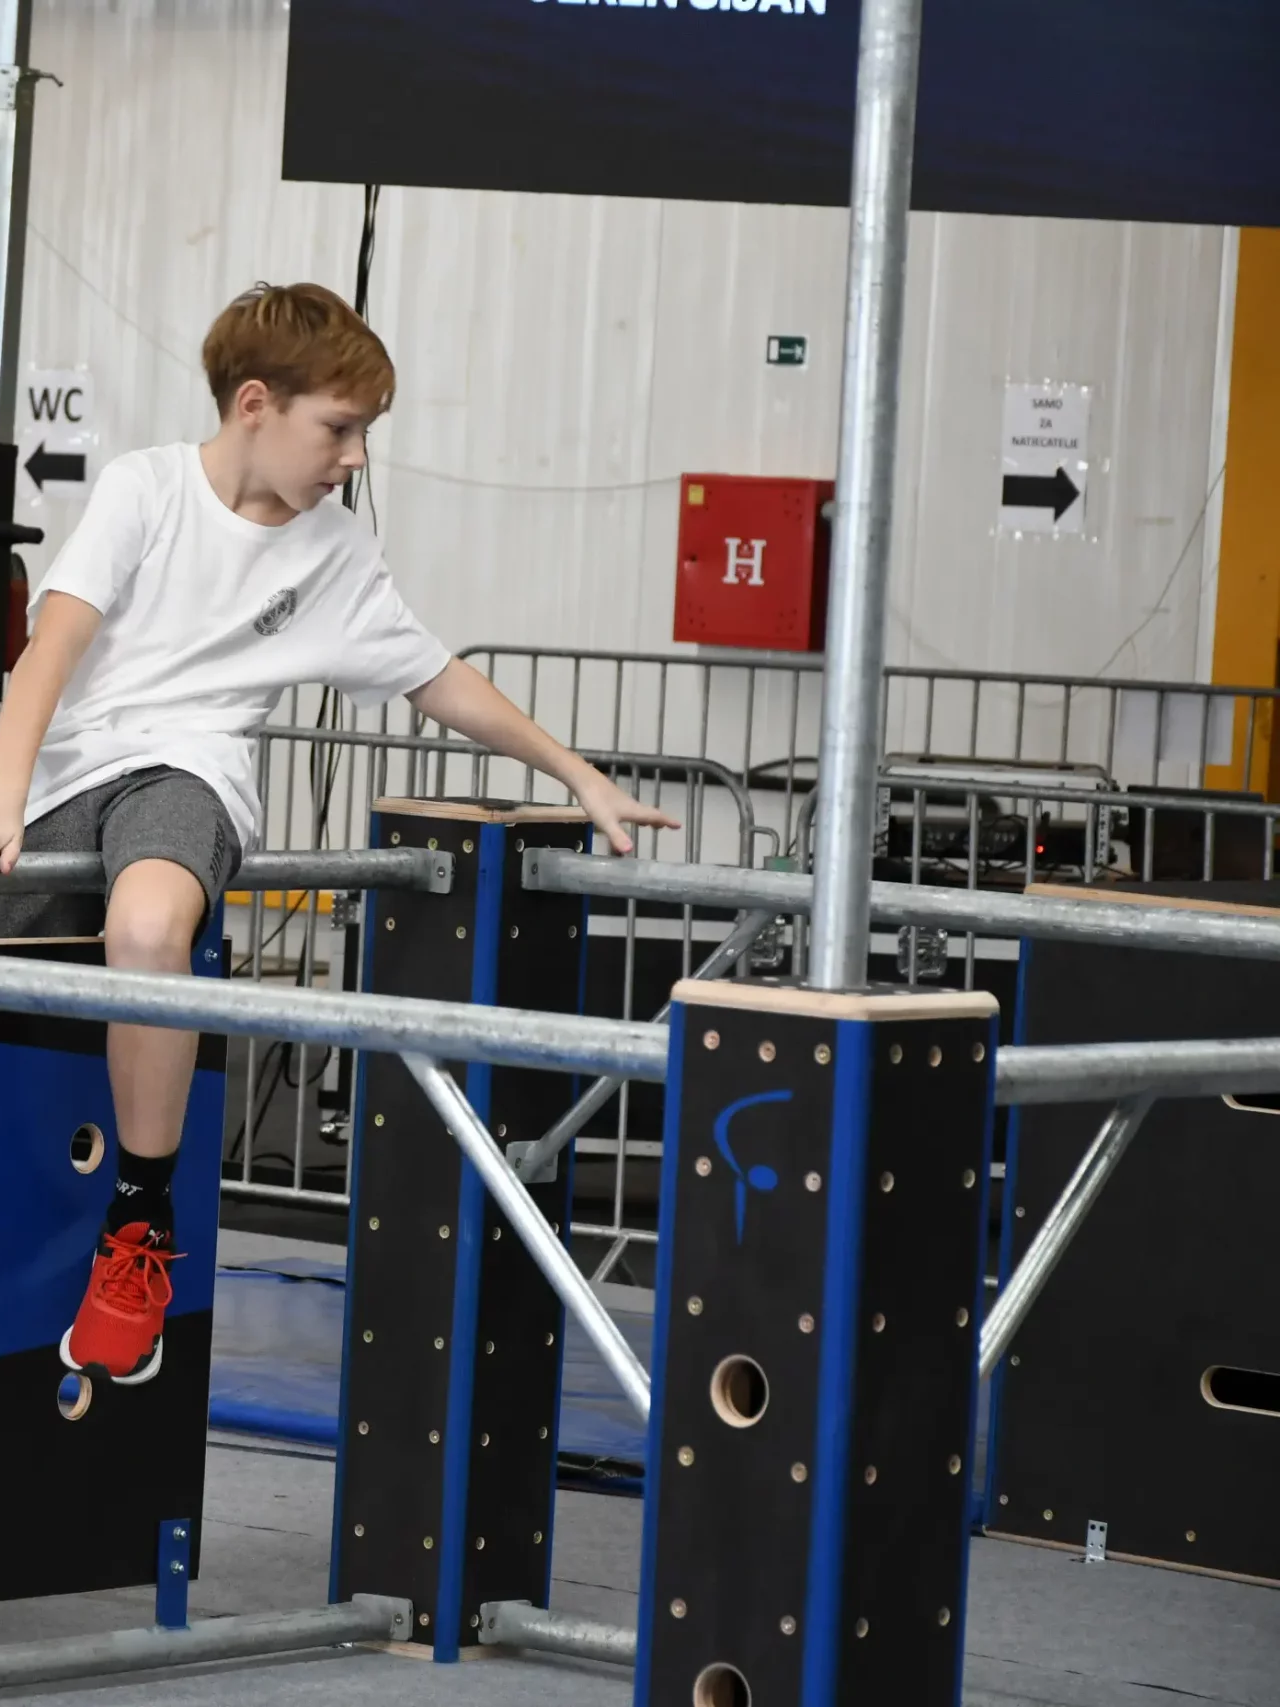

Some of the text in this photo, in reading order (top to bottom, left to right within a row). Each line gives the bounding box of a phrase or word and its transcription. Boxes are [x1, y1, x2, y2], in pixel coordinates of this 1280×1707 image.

[29, 387, 83, 422] WC
[1032, 399, 1063, 410] SAMO
[1040, 418, 1052, 428] ZA
[722, 537, 767, 586] H
